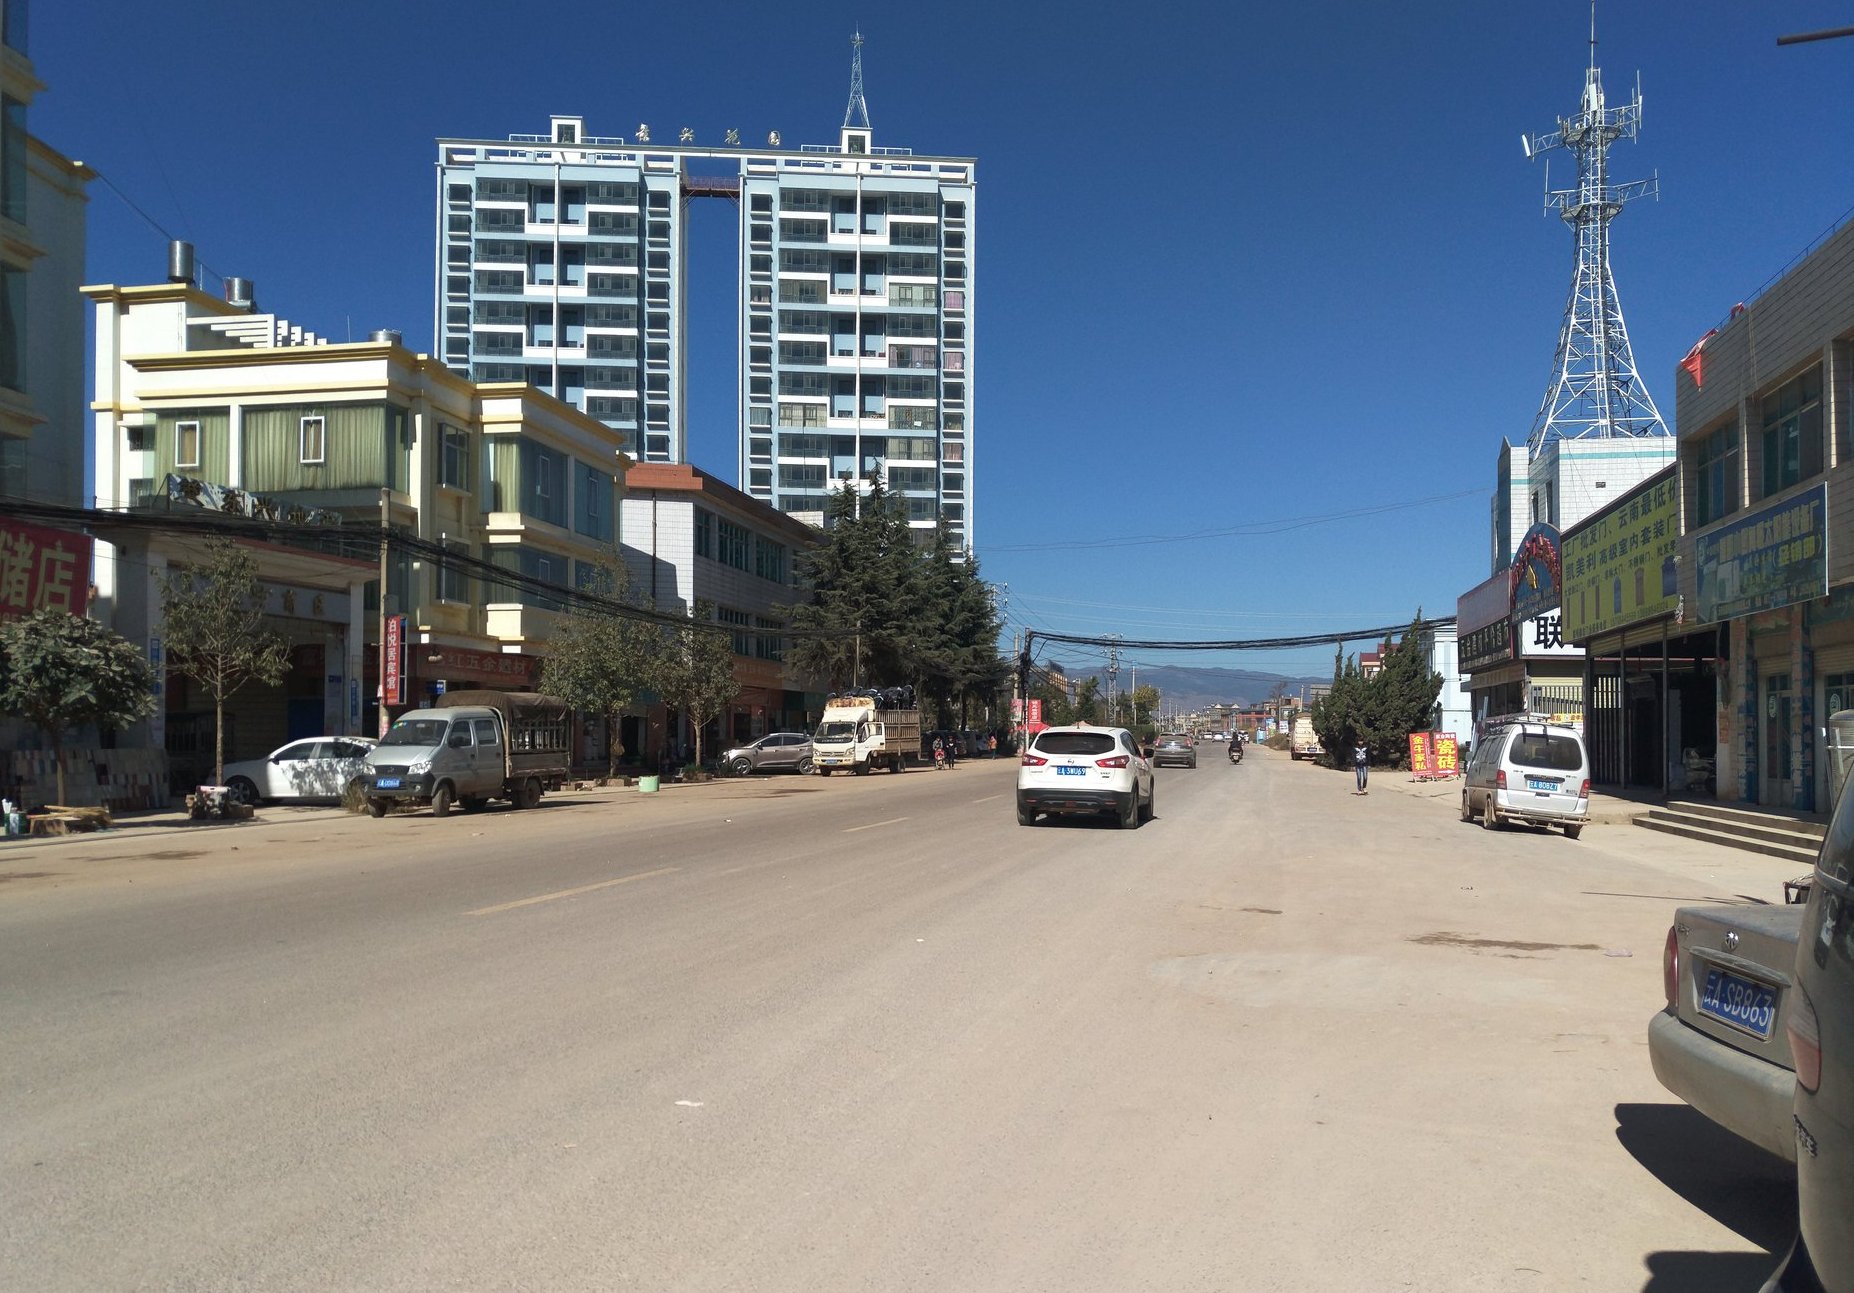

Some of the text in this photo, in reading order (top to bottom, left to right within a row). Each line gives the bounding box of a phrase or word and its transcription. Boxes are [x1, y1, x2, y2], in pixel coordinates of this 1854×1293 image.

[438, 653, 526, 675] 红五金建材
[1436, 739, 1456, 769] 瓷砖
